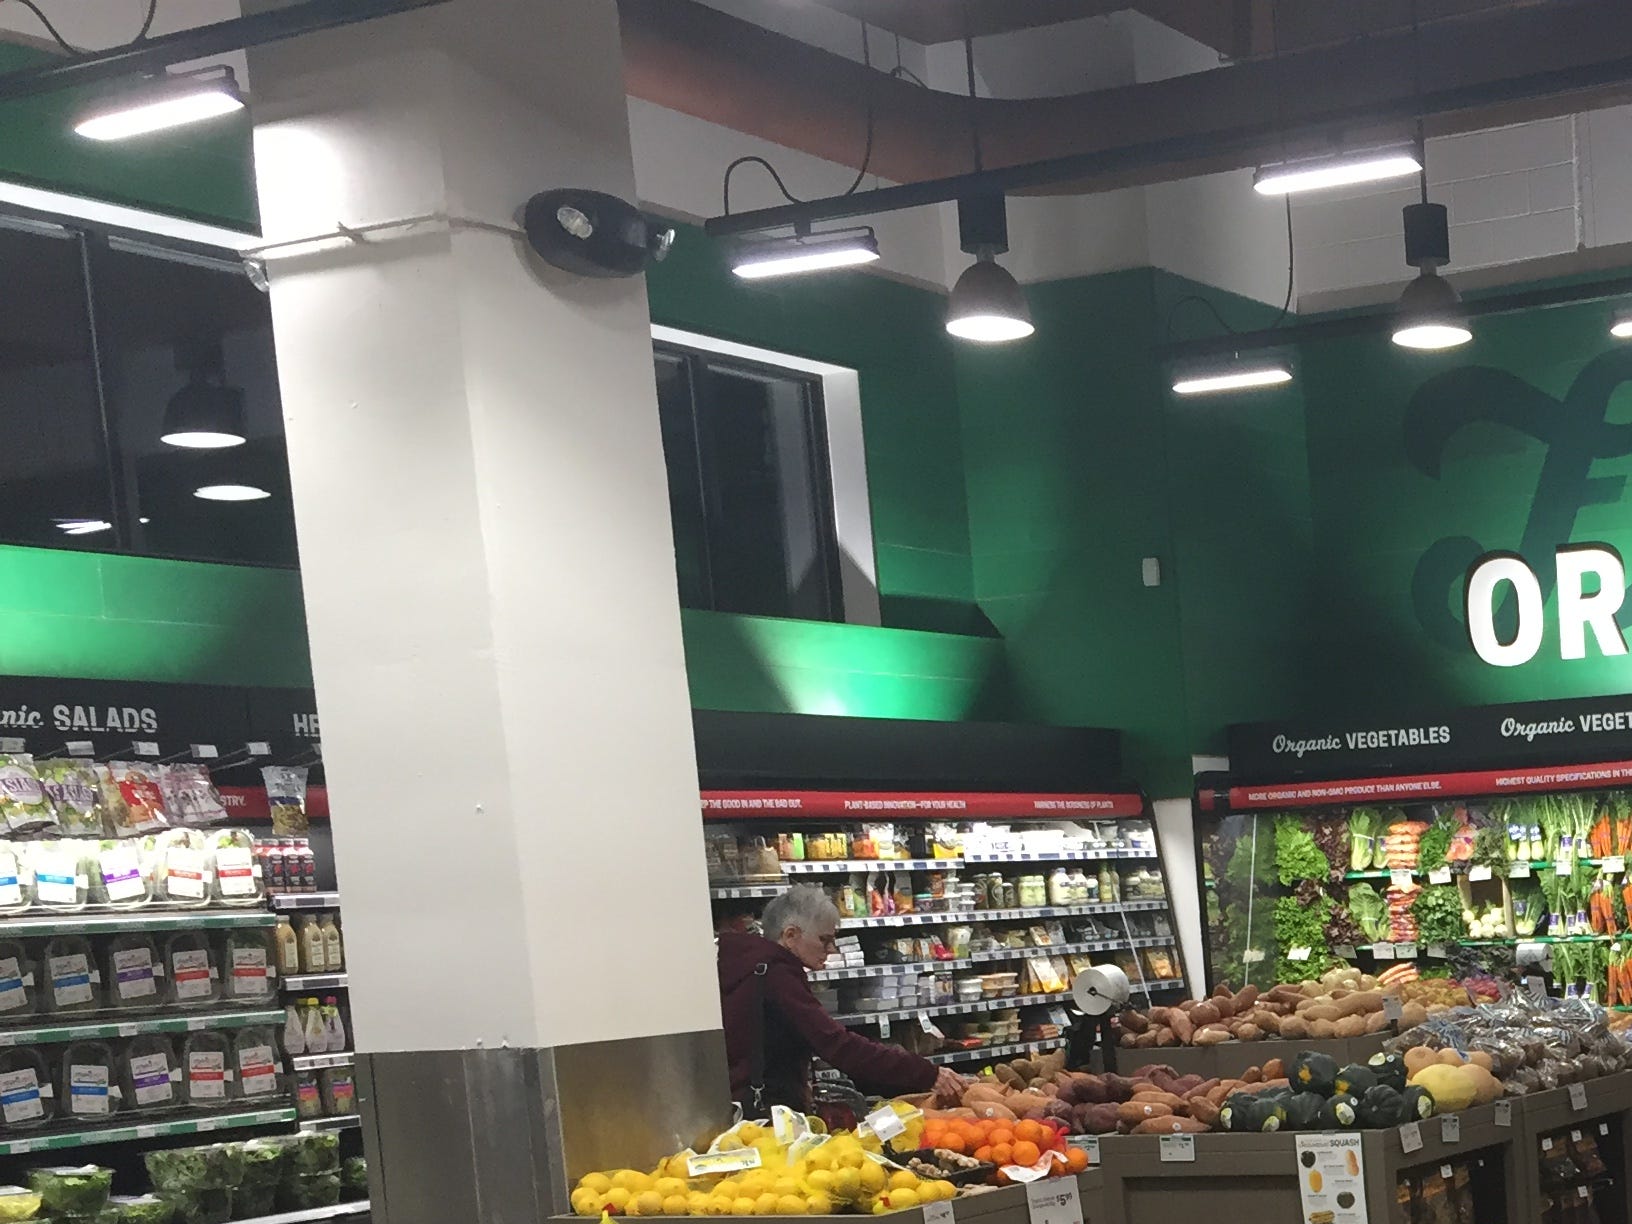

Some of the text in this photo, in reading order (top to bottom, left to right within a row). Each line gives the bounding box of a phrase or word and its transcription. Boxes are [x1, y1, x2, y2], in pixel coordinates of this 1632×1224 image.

[0, 704, 158, 733] nic SALADS
[1501, 717, 1575, 742] Organic
[1273, 726, 1450, 757] Organic VEGETABLES
[1527, 775, 1555, 784] QUALITY
[1556, 770, 1612, 783] SPECIFICATIONS
[1613, 769, 1620, 778] IN
[220, 794, 247, 808] STRY.
[1330, 1138, 1360, 1147] SQUASH
